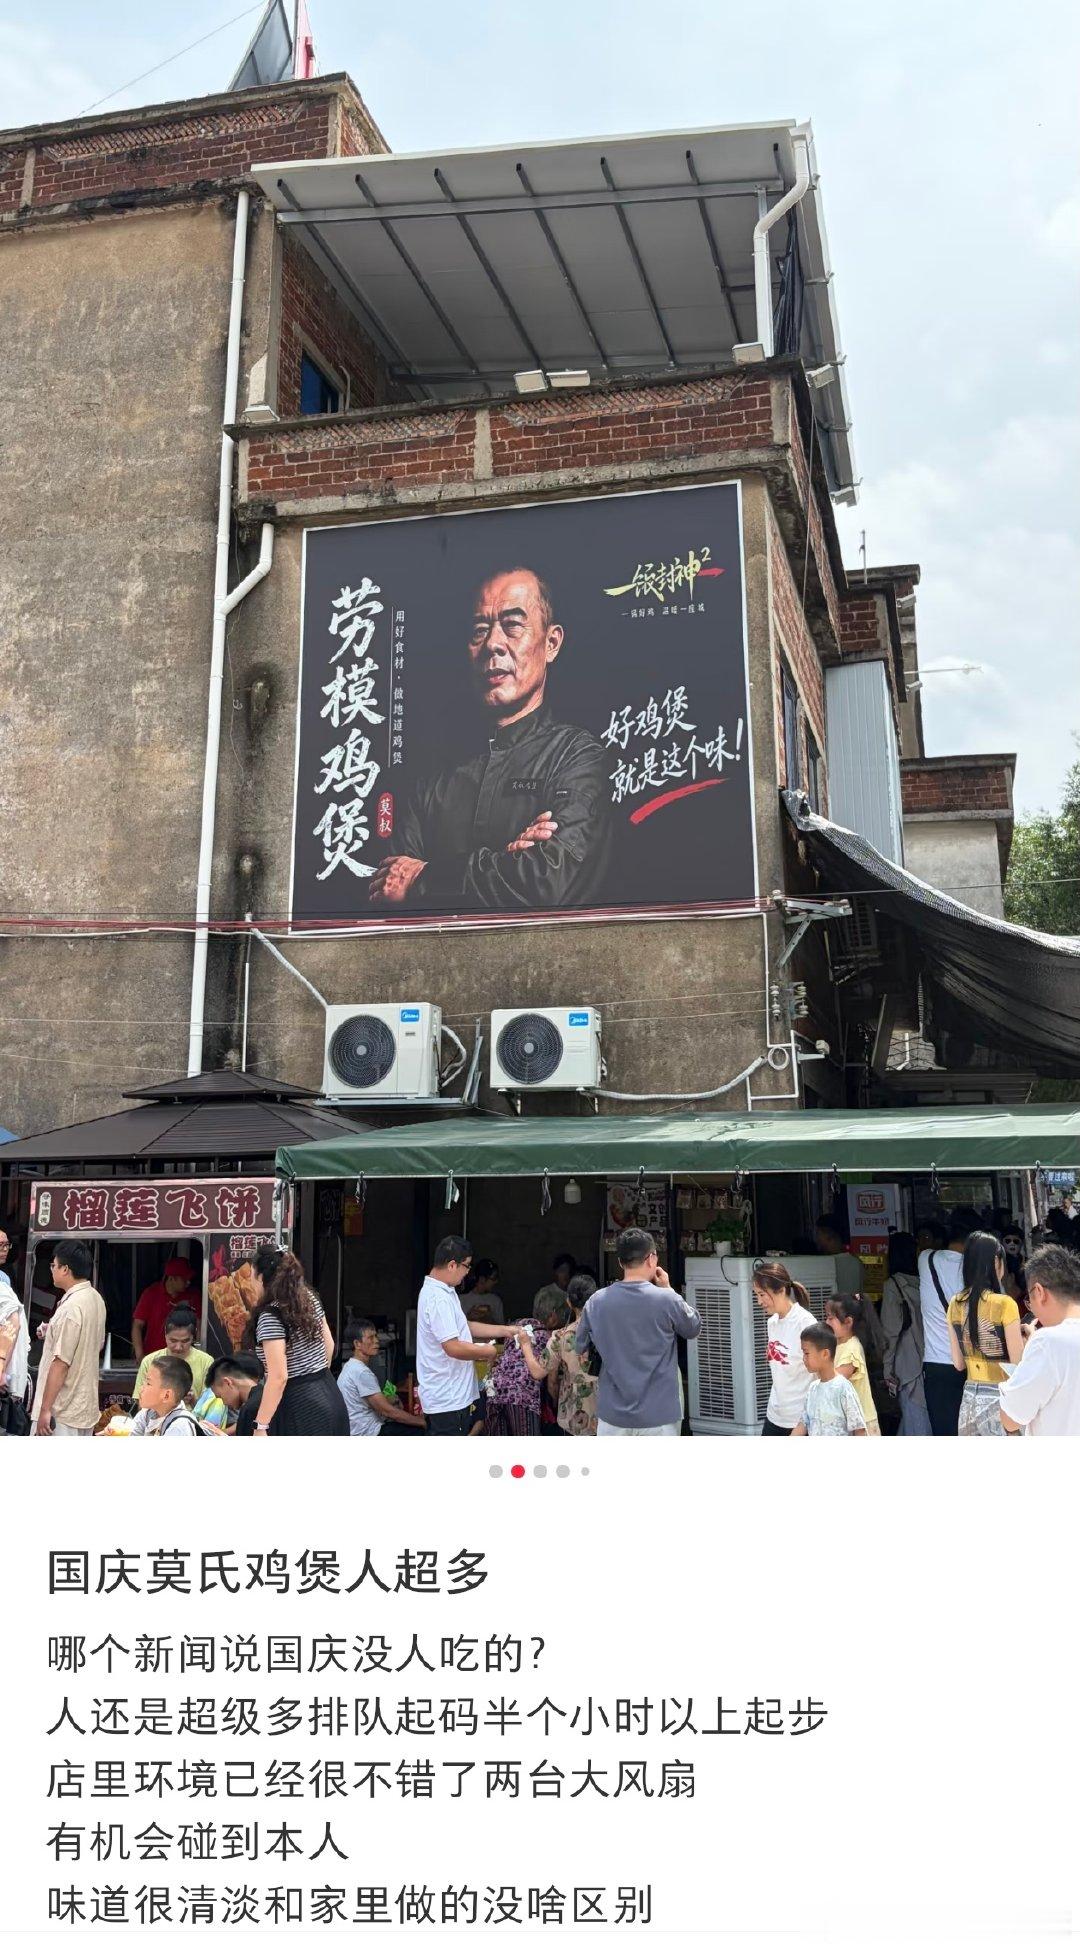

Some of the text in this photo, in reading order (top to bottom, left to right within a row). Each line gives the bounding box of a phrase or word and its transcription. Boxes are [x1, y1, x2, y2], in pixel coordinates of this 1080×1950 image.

[313, 577, 386, 880] 劳模鸡煲
[600, 685, 697, 749] 好鸡煲
[608, 717, 743, 803] 就是这个味！
[378, 798, 393, 834] 莫叔
[64, 1186, 260, 1229] 榴莲飞饼
